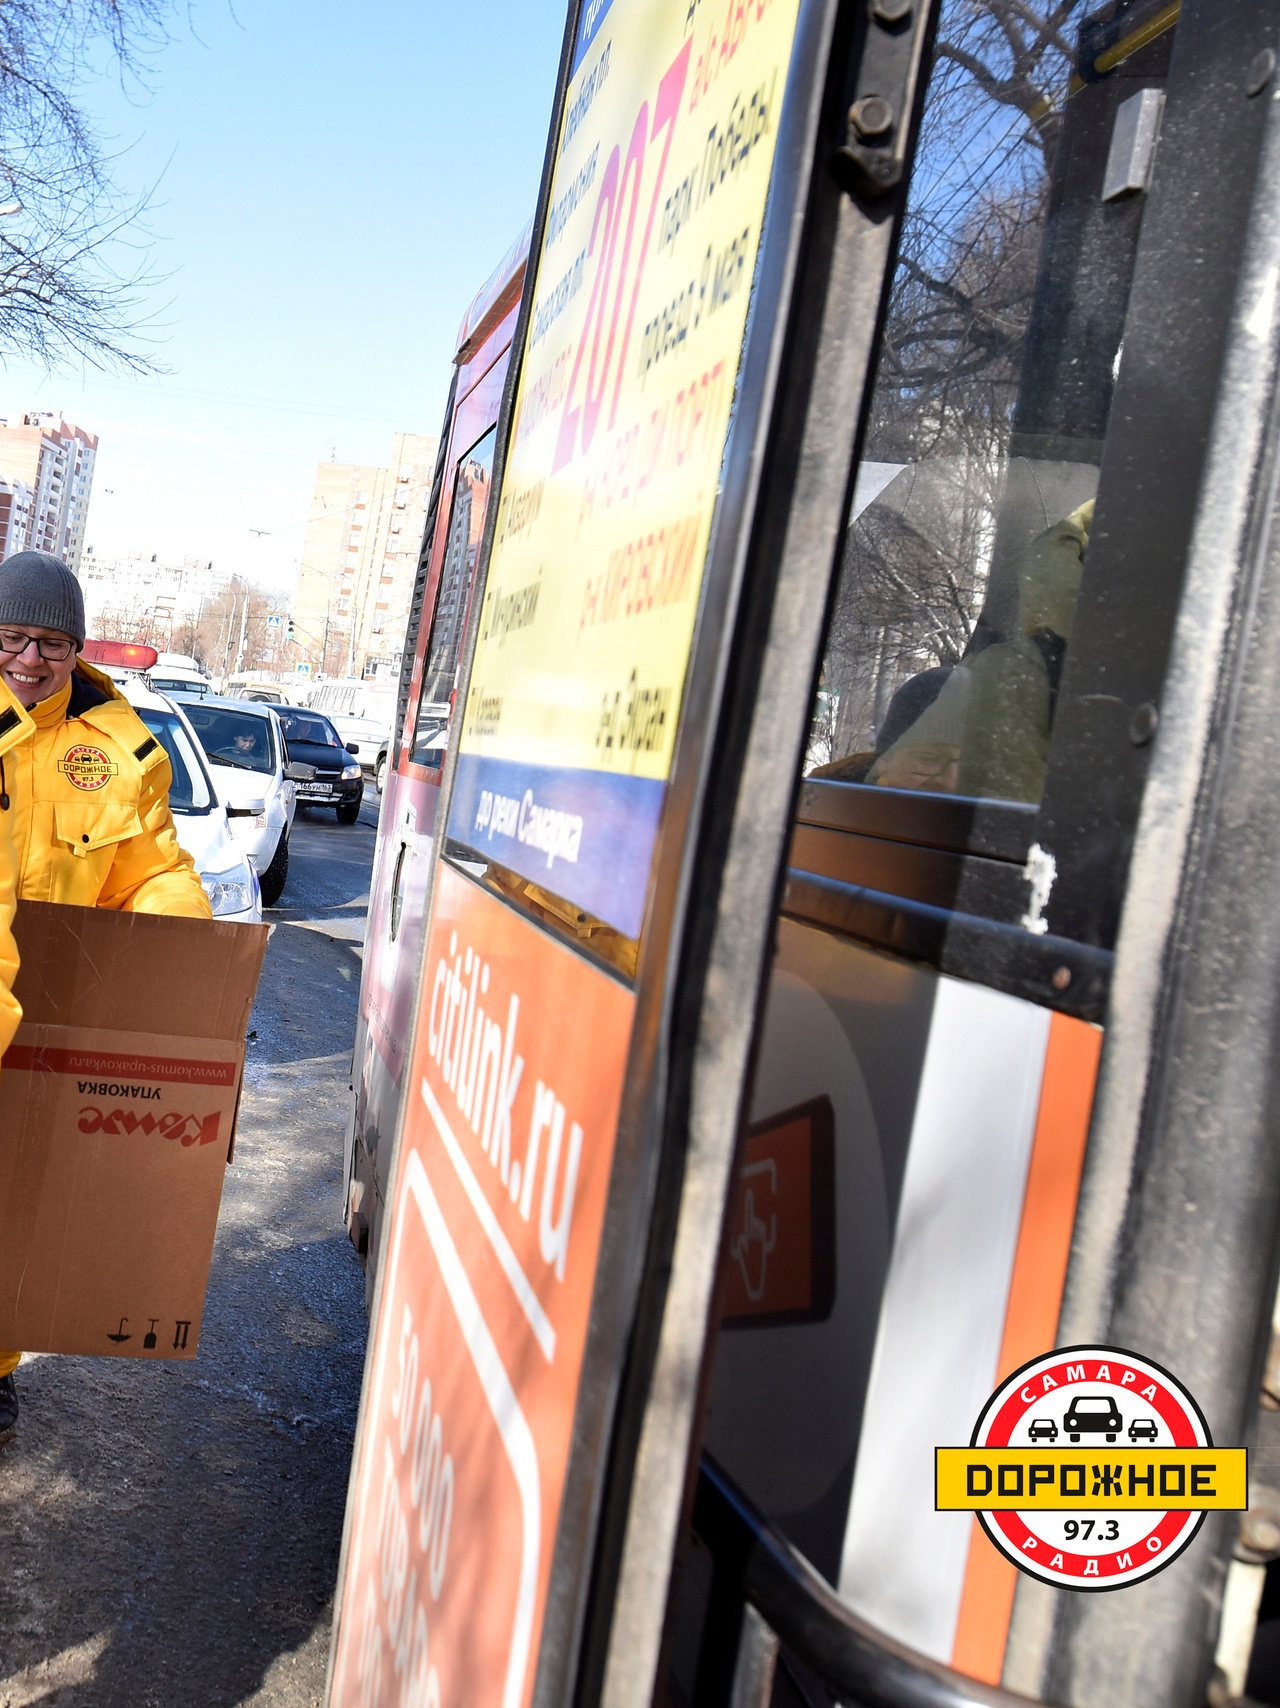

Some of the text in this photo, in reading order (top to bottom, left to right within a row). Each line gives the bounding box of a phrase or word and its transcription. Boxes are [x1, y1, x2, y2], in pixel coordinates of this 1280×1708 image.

[561, 64, 598, 152] Хлебная
[658, 66, 778, 258] парк Победы
[545, 140, 600, 253] Филармония
[551, 31, 694, 476] 207
[637, 282, 695, 391] проезд
[694, 248, 713, 328] 9
[707, 227, 751, 322] мая
[528, 267, 572, 354] Самарская
[601, 488, 704, 623] КИРОВСКИЙ
[619, 665, 673, 776] Экран
[475, 789, 584, 869] до реки Самарка
[70, 1055, 228, 1080] www.komus-upakovka.ru
[77, 1081, 162, 1101] УПАКОВКА
[429, 930, 584, 1284] citilink.ru
[77, 1105, 222, 1148] Комус
[392, 1303, 454, 1603] 50 000
[376, 1435, 441, 1708] ТОВАР
